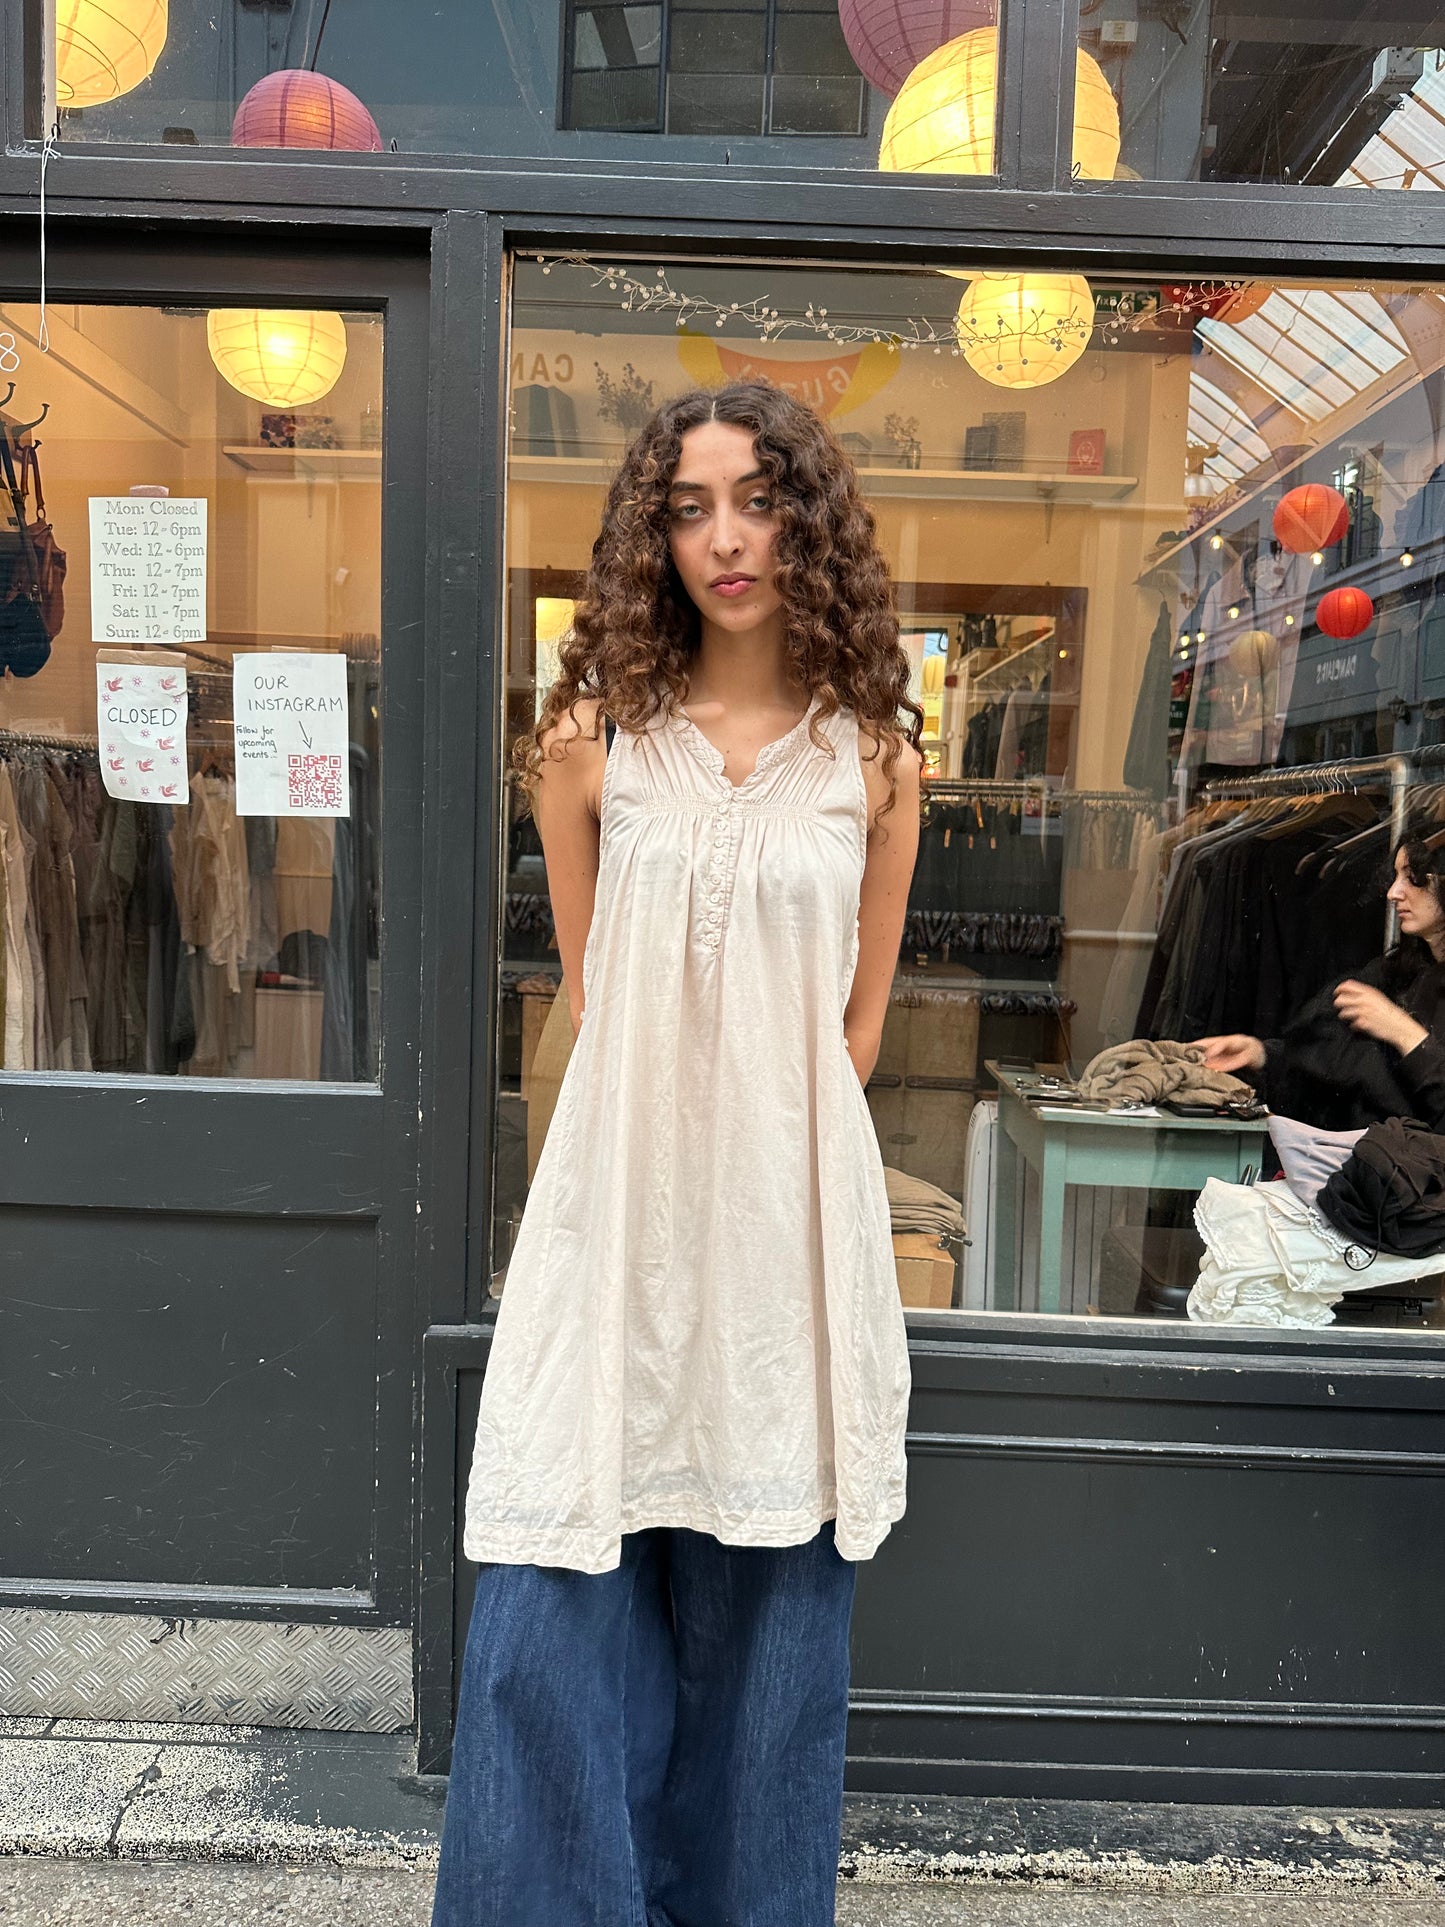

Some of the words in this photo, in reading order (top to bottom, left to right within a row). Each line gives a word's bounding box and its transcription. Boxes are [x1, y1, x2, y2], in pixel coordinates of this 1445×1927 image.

[106, 501, 144, 515] Mon:
[149, 501, 199, 515] Closed
[104, 521, 137, 536] Tue:
[101, 542, 142, 556] Wed:
[98, 563, 136, 577] Thu:
[112, 583, 137, 598] Fri:
[112, 604, 139, 618] Sat:
[105, 624, 140, 638] Sun:
[254, 675, 289, 690] OUR
[248, 696, 344, 712] INSTAGRAM
[107, 707, 177, 726] CLOSED
[236, 725, 258, 734] Follow
[260, 725, 274, 740] for
[238, 740, 278, 753] upcoming
